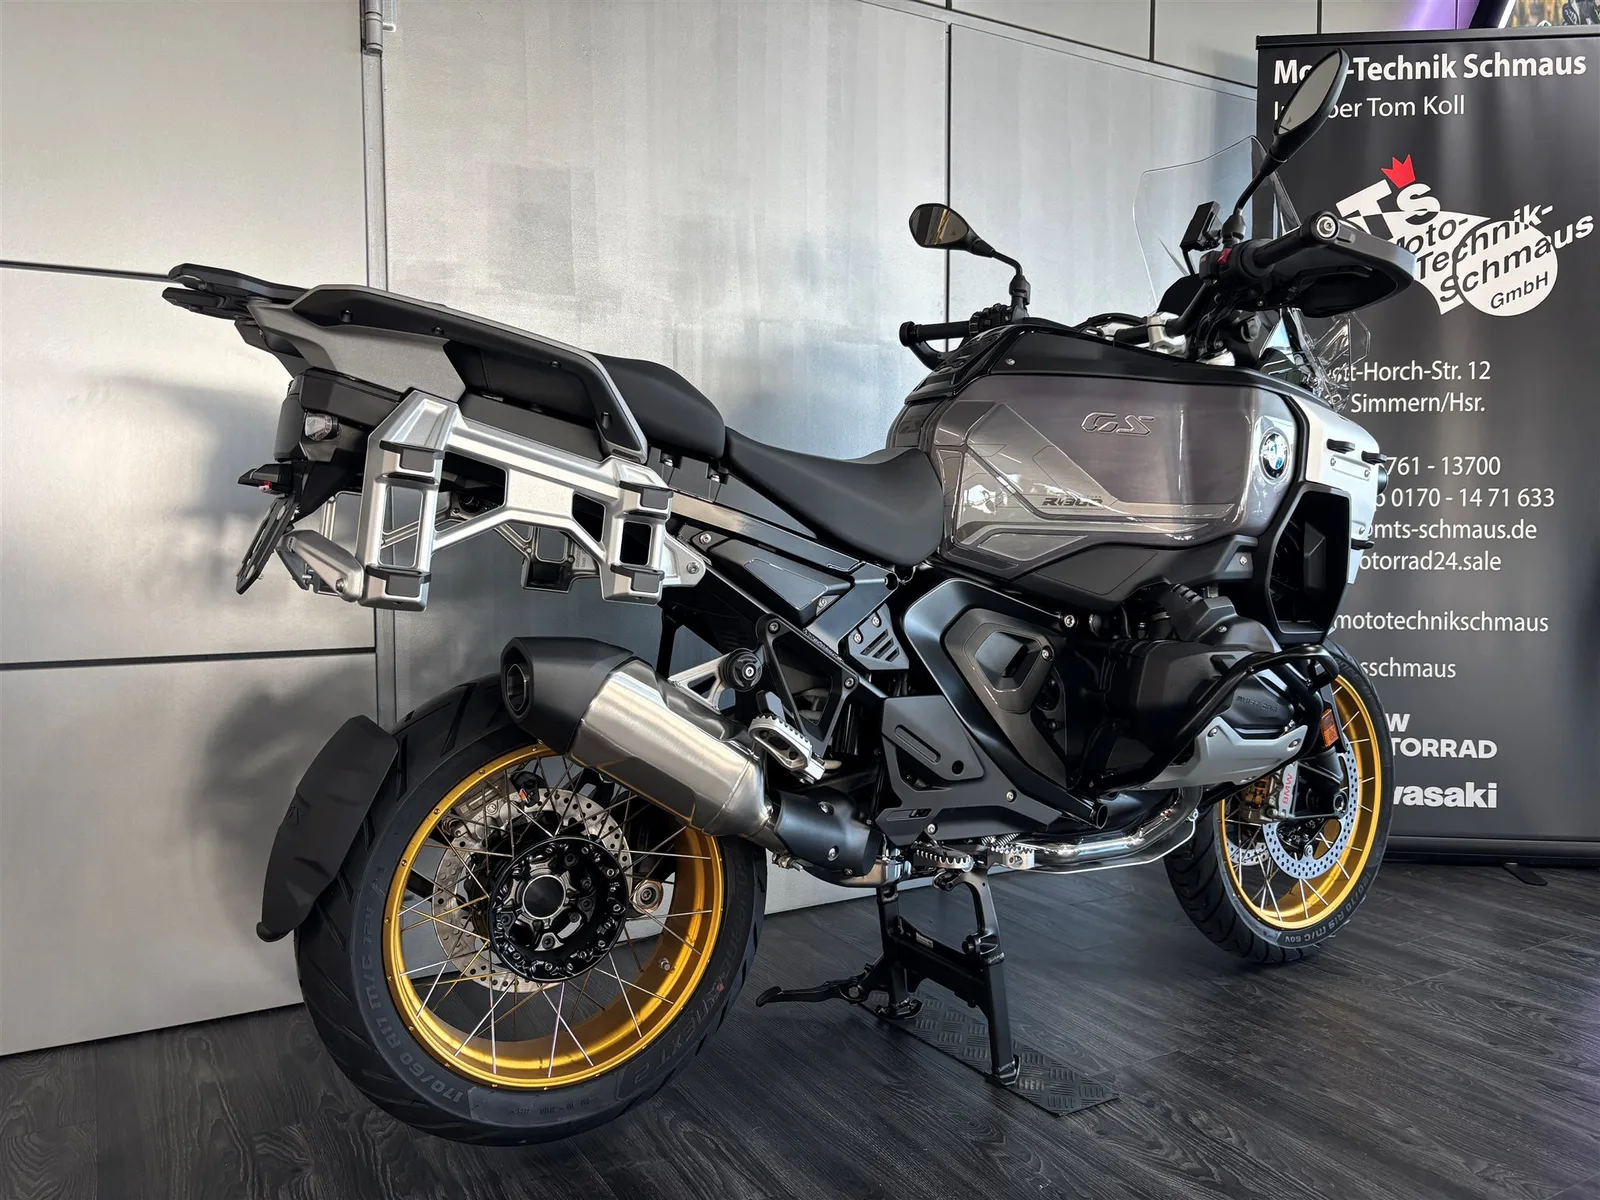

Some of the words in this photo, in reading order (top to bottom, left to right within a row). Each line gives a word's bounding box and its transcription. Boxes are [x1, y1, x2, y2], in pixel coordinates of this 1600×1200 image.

[1274, 53, 1457, 85] M-Technik
[1463, 51, 1587, 78] Schmaus
[1366, 97, 1416, 117] Tom
[1423, 94, 1465, 116] Koll
[1416, 203, 1554, 280] Technik-
[1489, 271, 1549, 310] GmbH
[1467, 359, 1492, 381] 12
[1350, 392, 1486, 414] Simmern/Hsr.
[1441, 456, 1501, 476] 13700
[1390, 487, 1441, 508] 0170
[1459, 487, 1483, 508] 14
[1487, 487, 1510, 508] 71
[1517, 487, 1556, 508] 633
[1368, 518, 1538, 540] mts-schmaus.de
[1359, 550, 1503, 572] otorrad24.sale
[1333, 609, 1550, 633] mototechnikschmaus
[1360, 656, 1457, 679] sschmaus
[1390, 737, 1498, 759] TORRAD
[1282, 773, 1294, 806] BMW
[1393, 782, 1498, 809] asaki
[399, 1052, 464, 1103] 170/60
